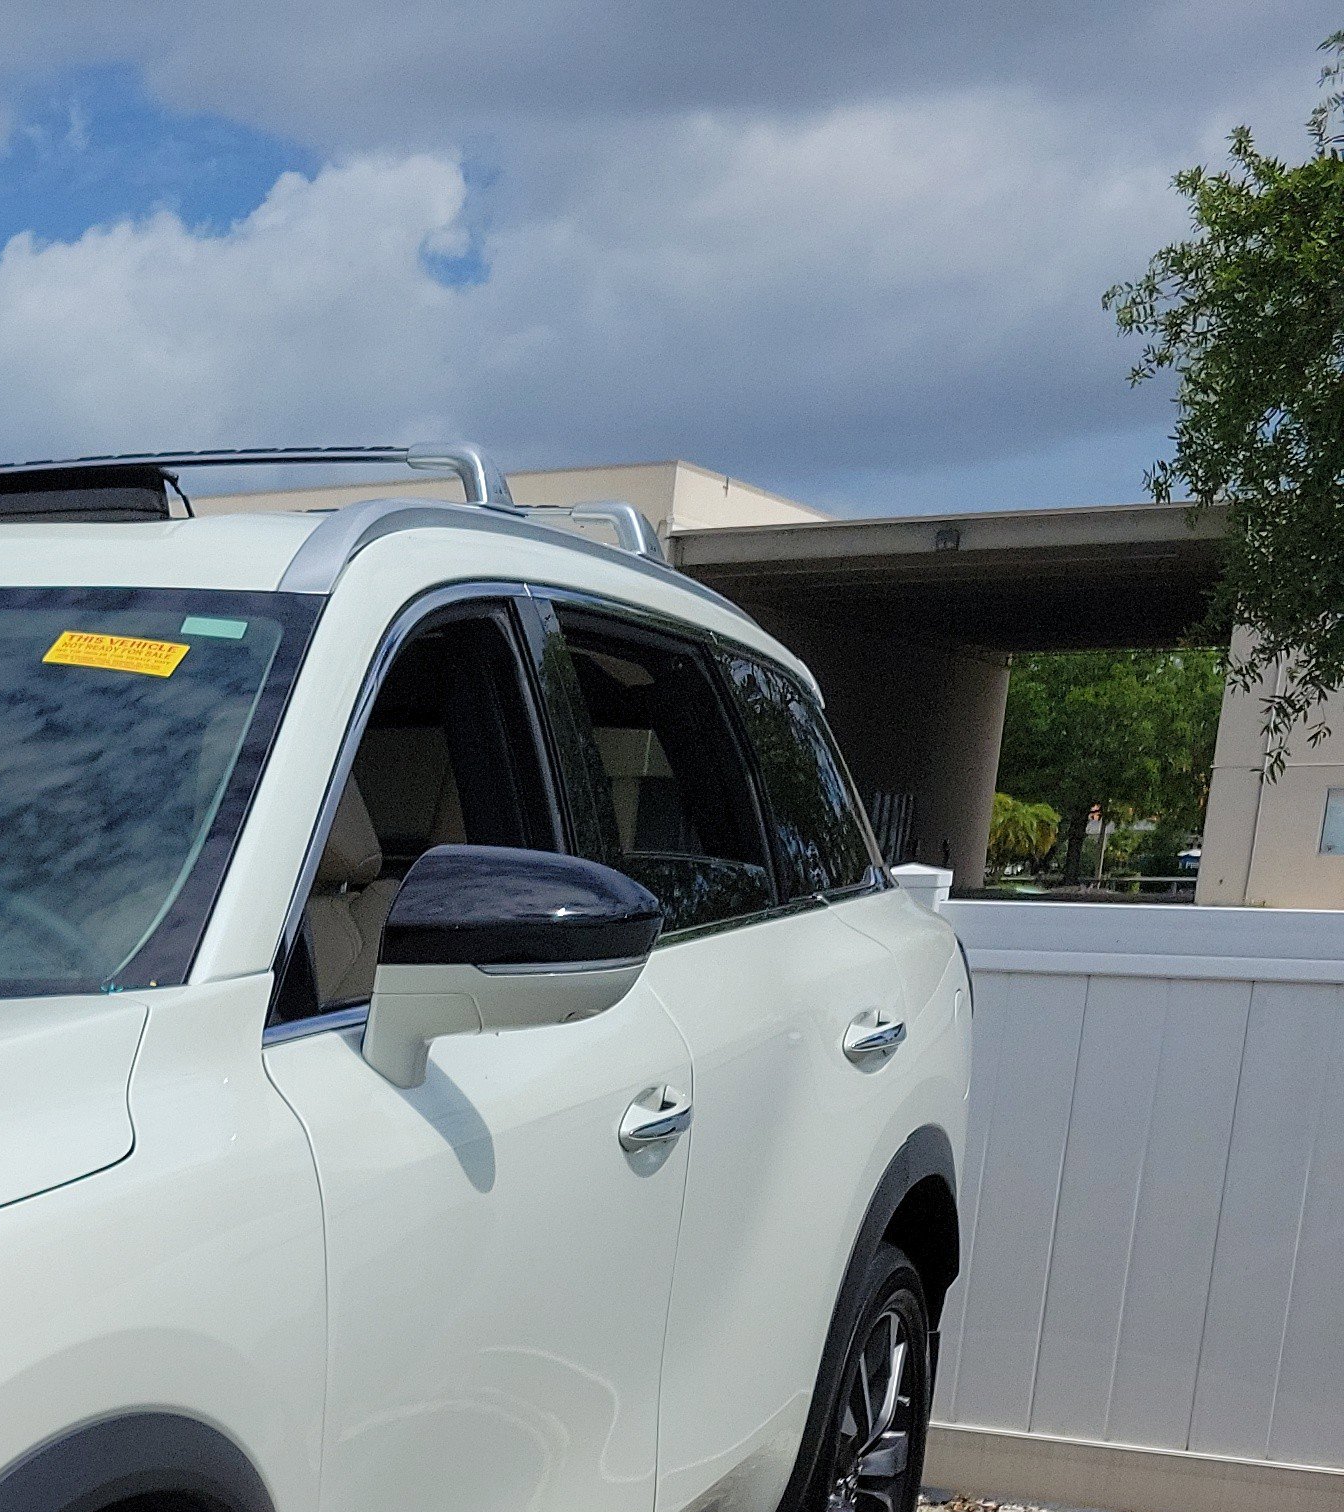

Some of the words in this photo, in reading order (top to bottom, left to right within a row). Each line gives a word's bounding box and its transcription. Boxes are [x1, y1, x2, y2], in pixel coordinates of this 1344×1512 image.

[62, 642, 83, 650] NOT
[85, 644, 120, 653] READY
[120, 648, 143, 656] FOR
[144, 650, 172, 660] SALE
[67, 634, 103, 644] THIS
[109, 637, 179, 654] VEHICLE
